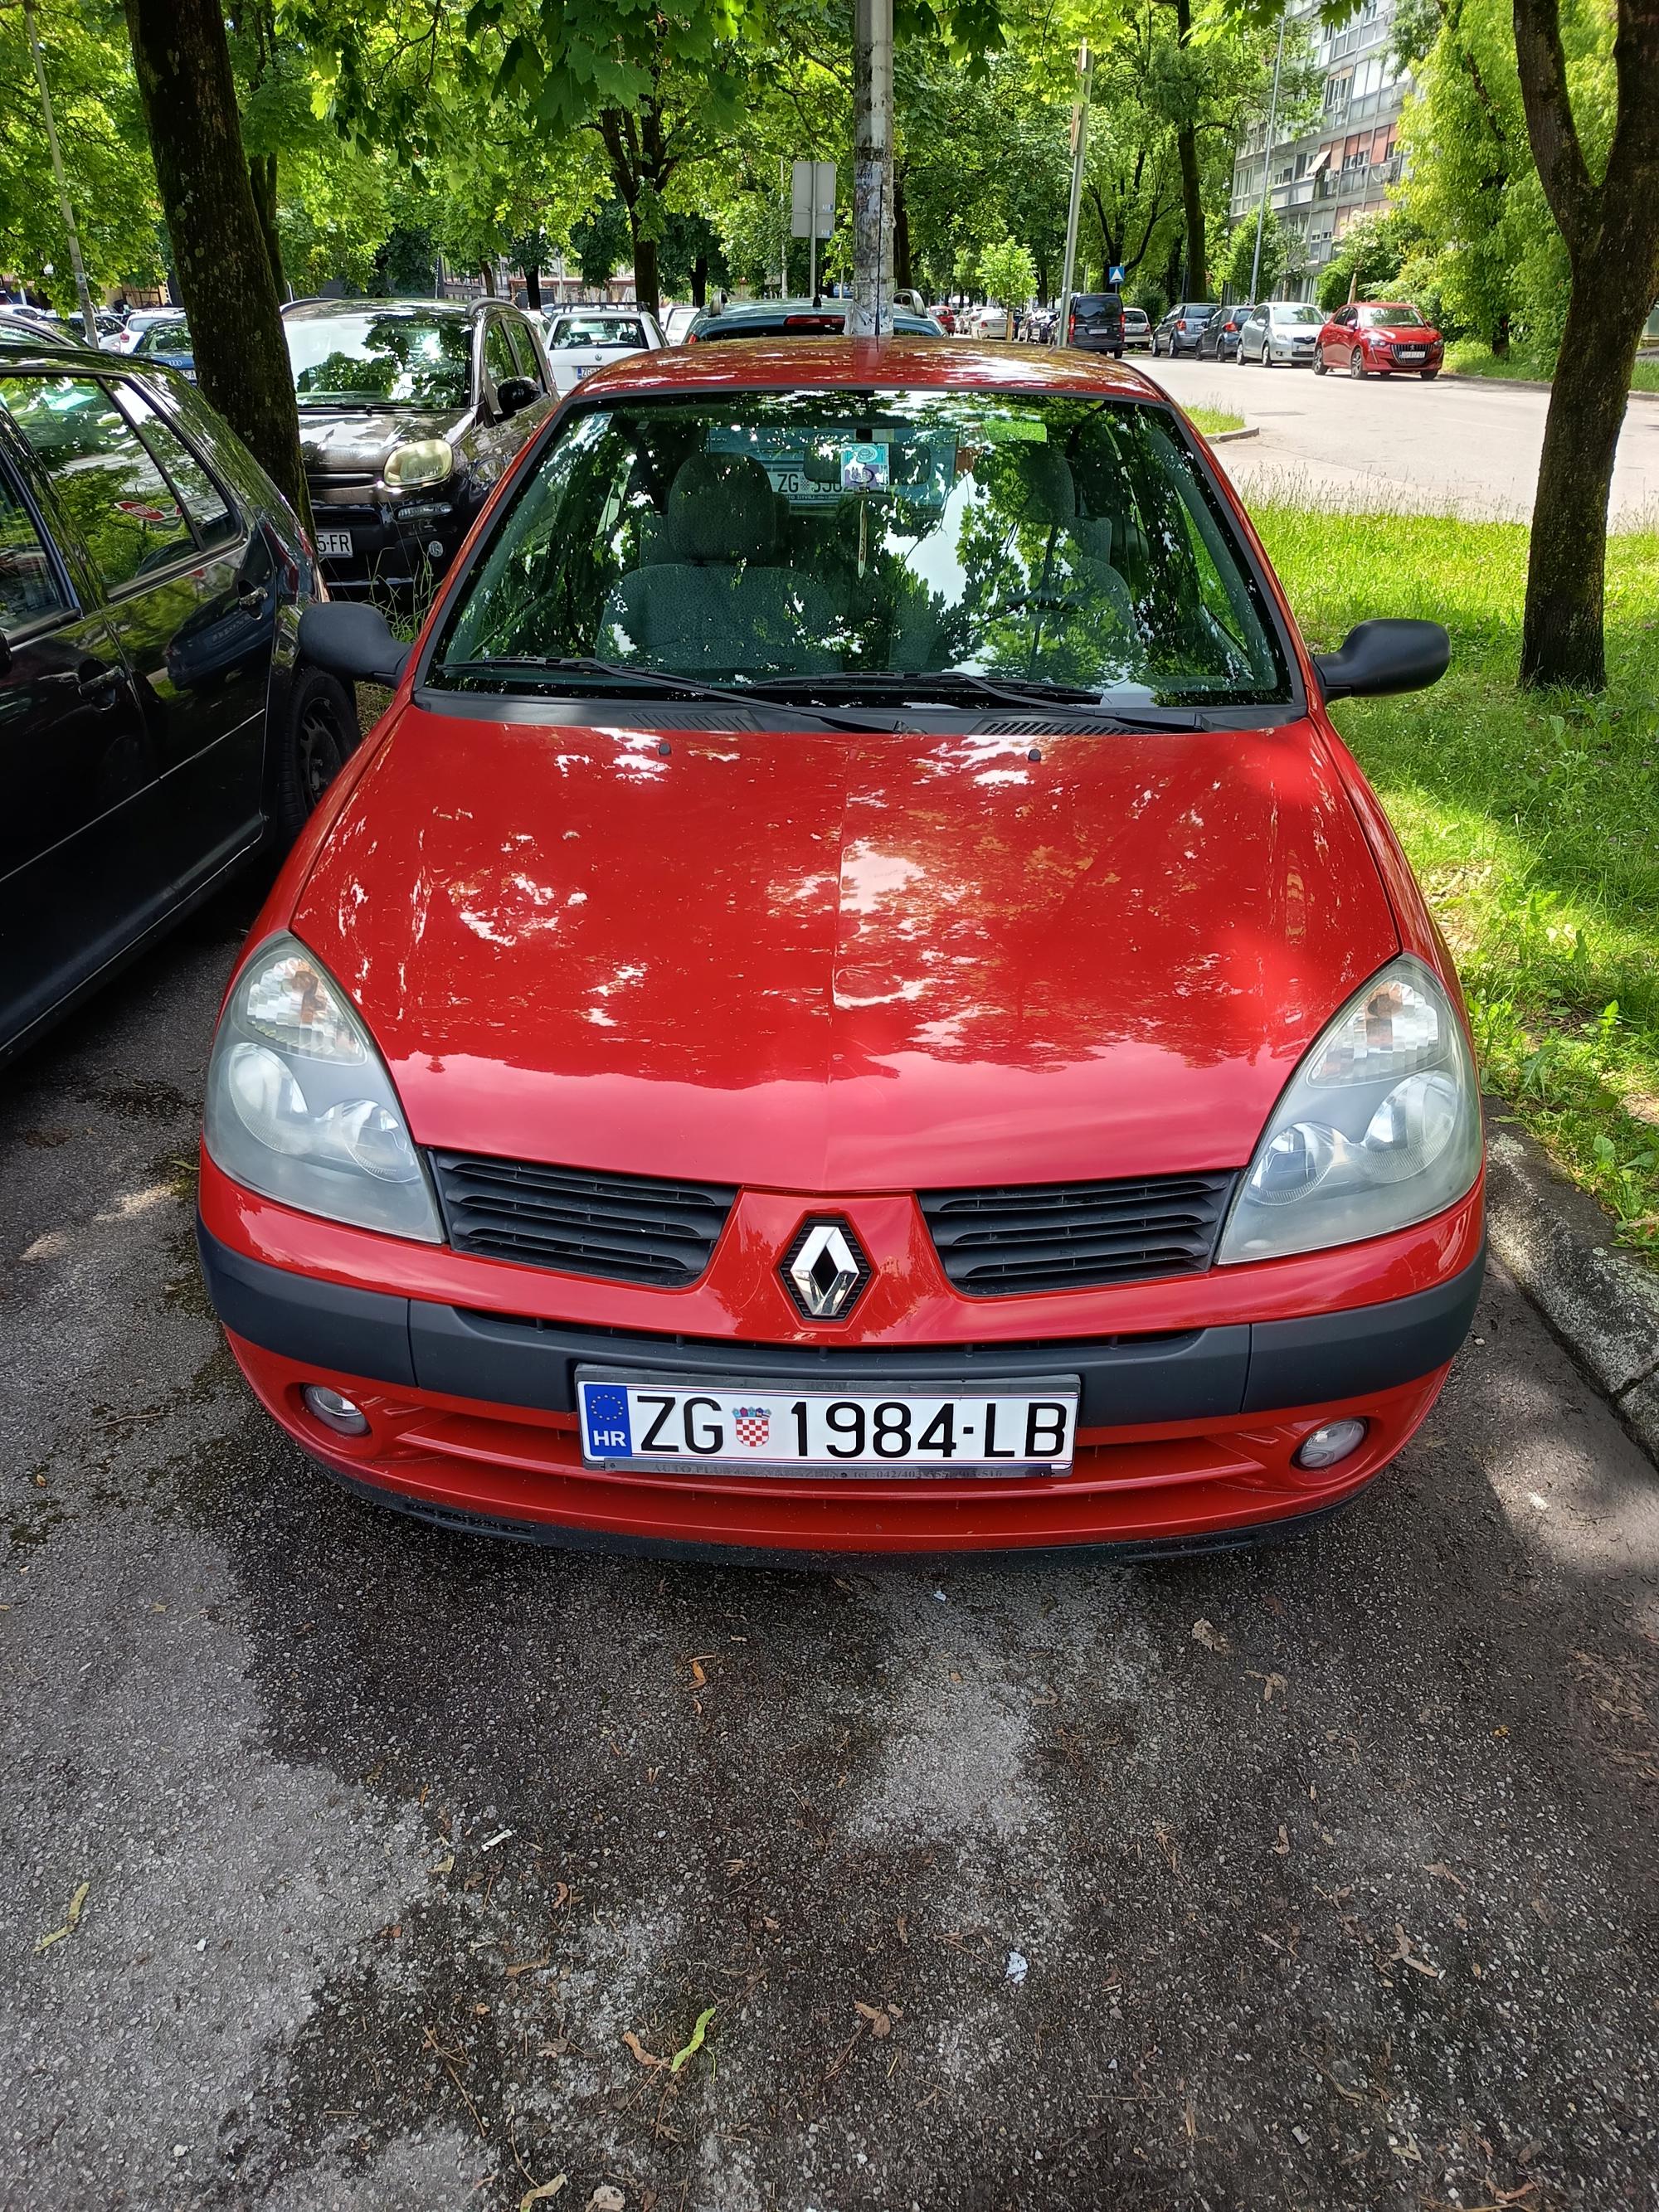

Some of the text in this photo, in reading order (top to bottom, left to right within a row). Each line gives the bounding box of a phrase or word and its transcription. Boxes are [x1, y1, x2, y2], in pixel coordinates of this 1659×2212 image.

[777, 474, 799, 493] ZG
[637, 1395, 1068, 1458] ZG 1984-LB
[593, 1430, 626, 1446] HR
